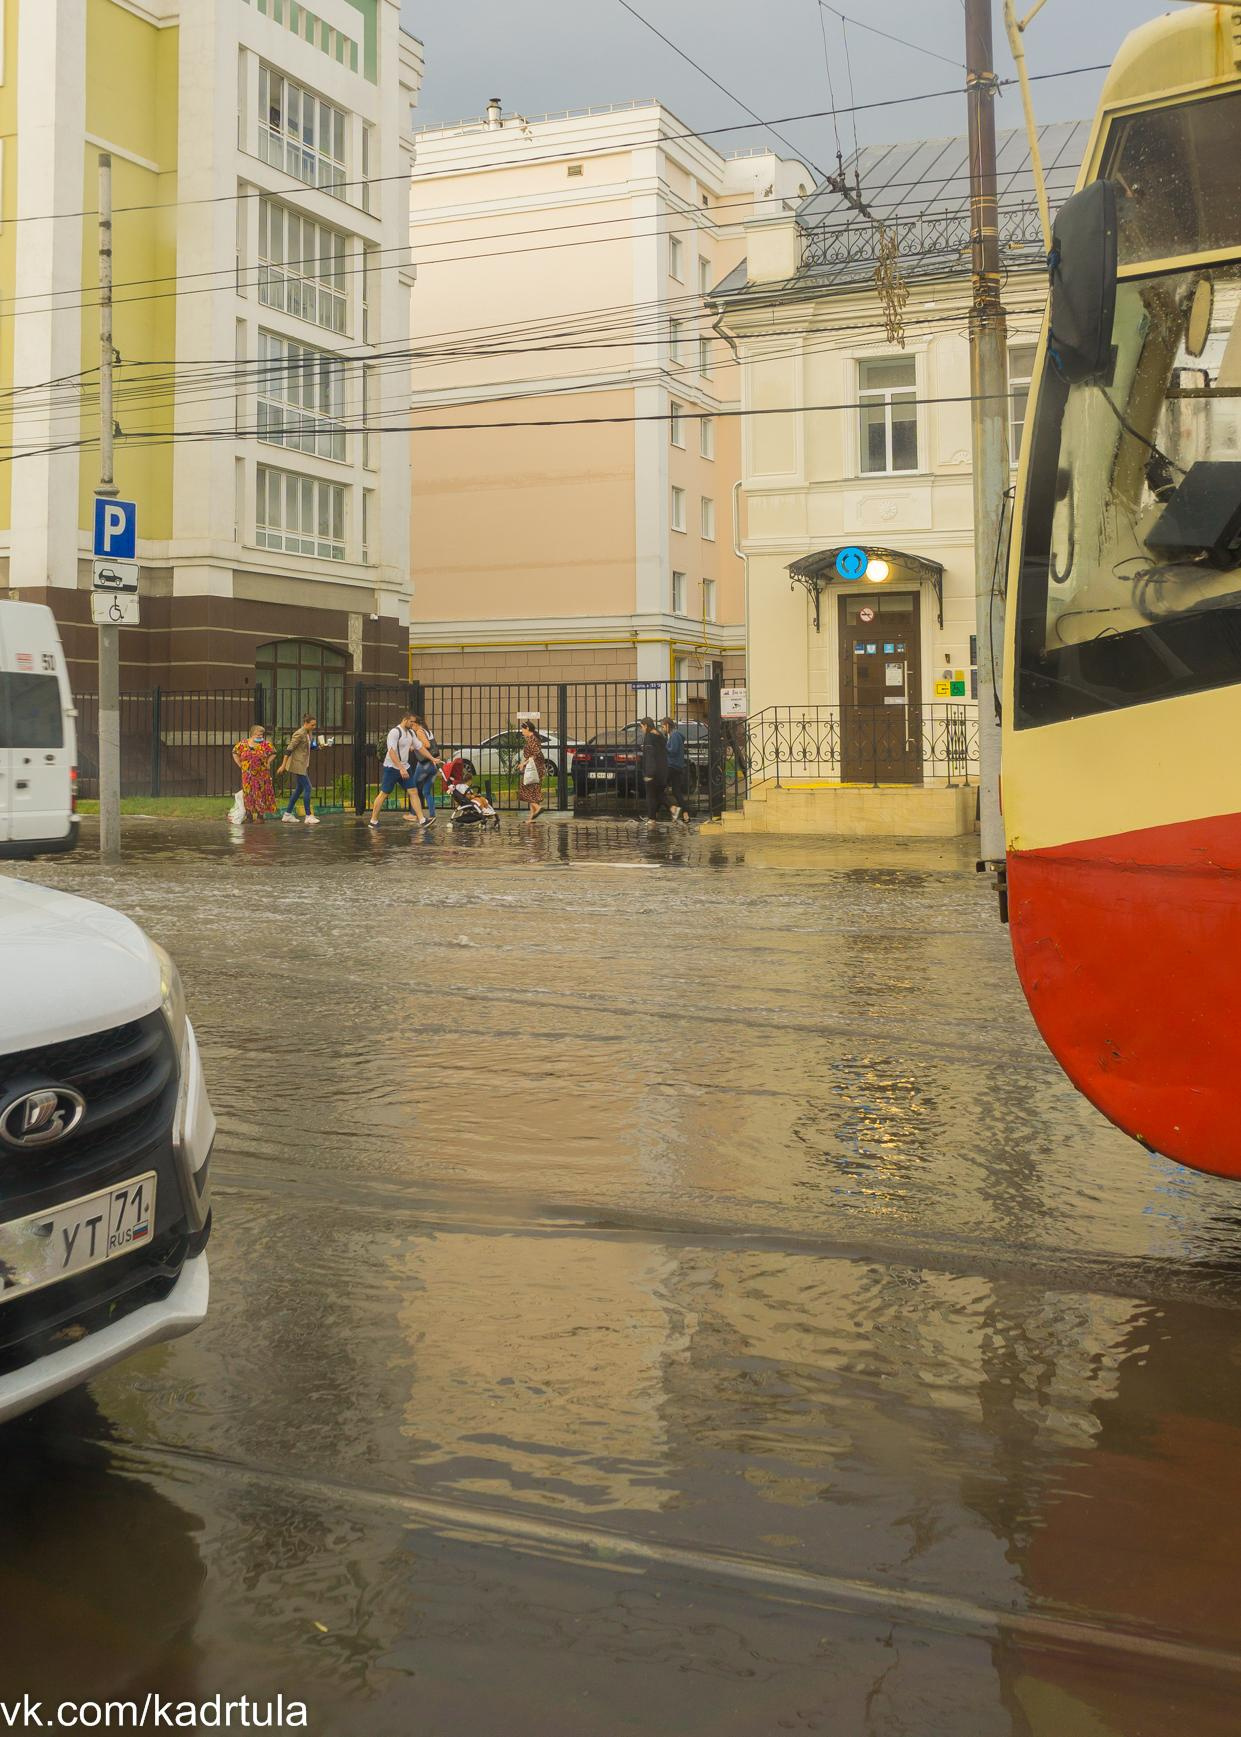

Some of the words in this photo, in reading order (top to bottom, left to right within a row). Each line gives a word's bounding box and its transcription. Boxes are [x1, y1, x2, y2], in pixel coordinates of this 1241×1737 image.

[104, 504, 126, 552] P
[114, 1184, 144, 1232] 71
[109, 1228, 132, 1249] RUS
